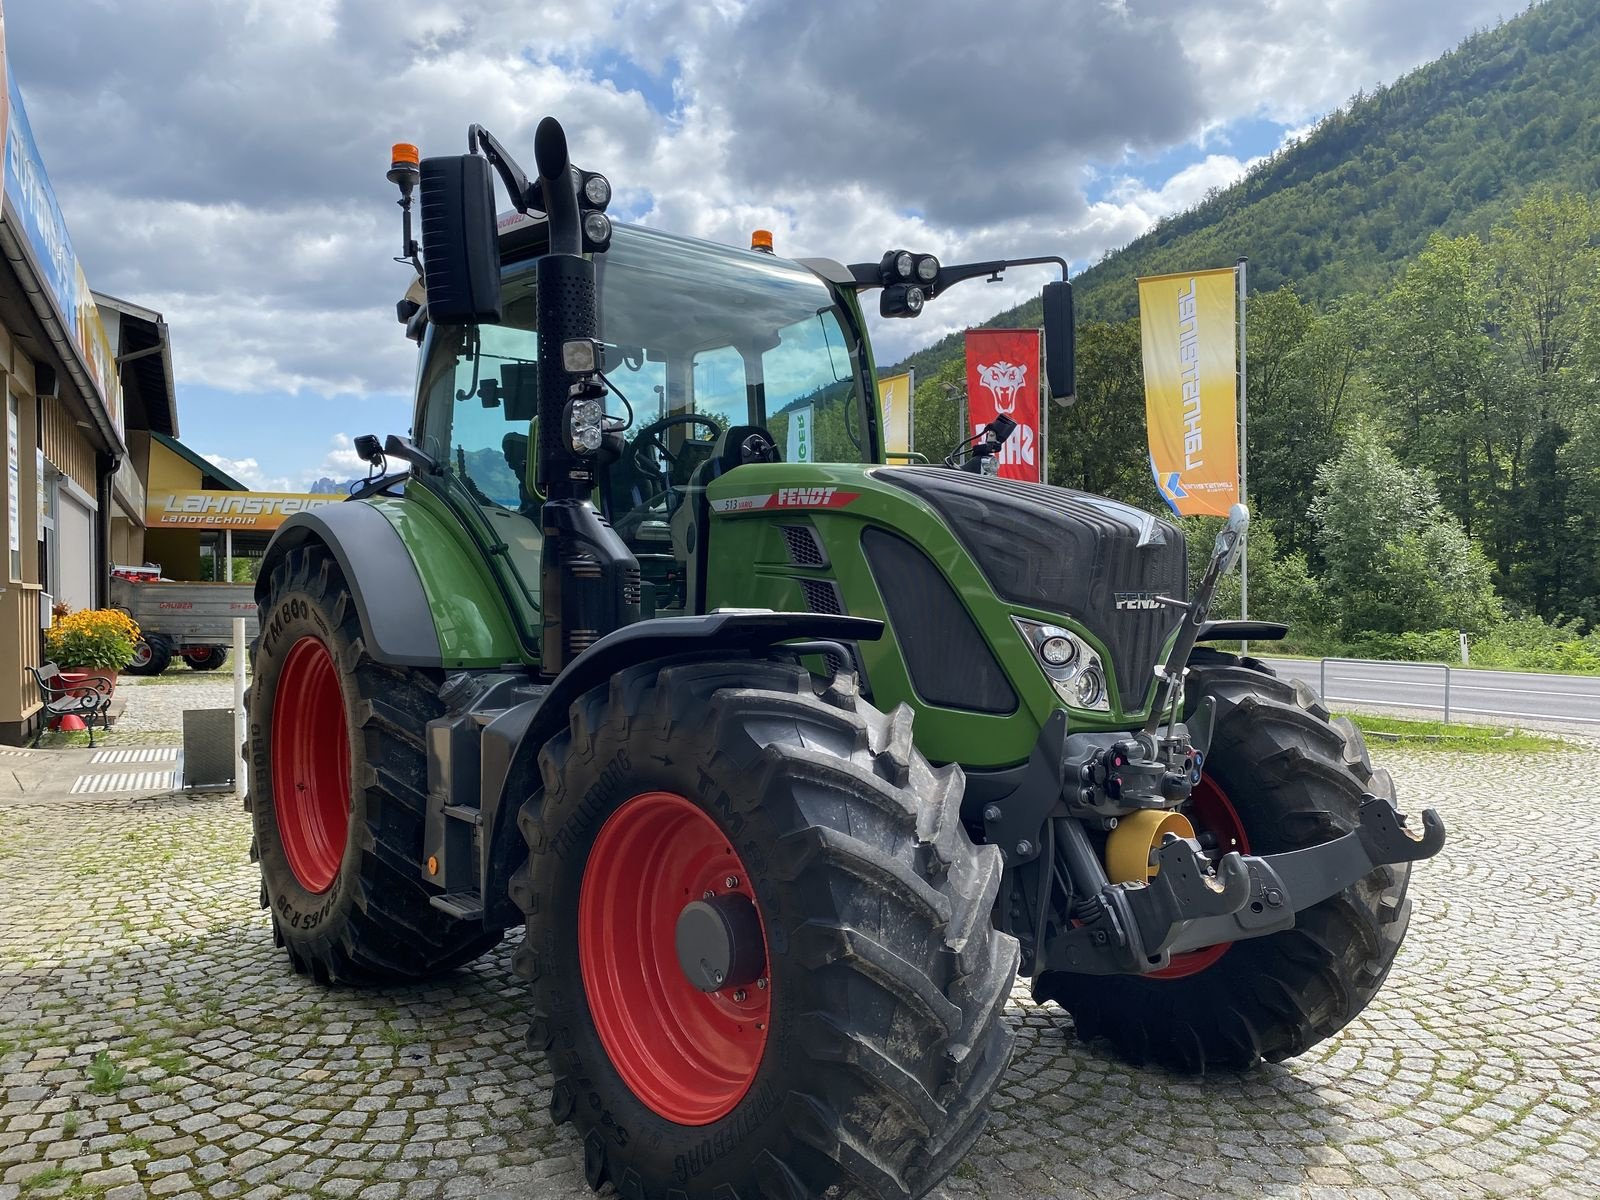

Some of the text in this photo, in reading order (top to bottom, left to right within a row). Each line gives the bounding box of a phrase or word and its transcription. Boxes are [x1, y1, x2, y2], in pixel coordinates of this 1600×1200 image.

[778, 487, 837, 505] FENDT
[725, 499, 752, 510] 513 VARIO
